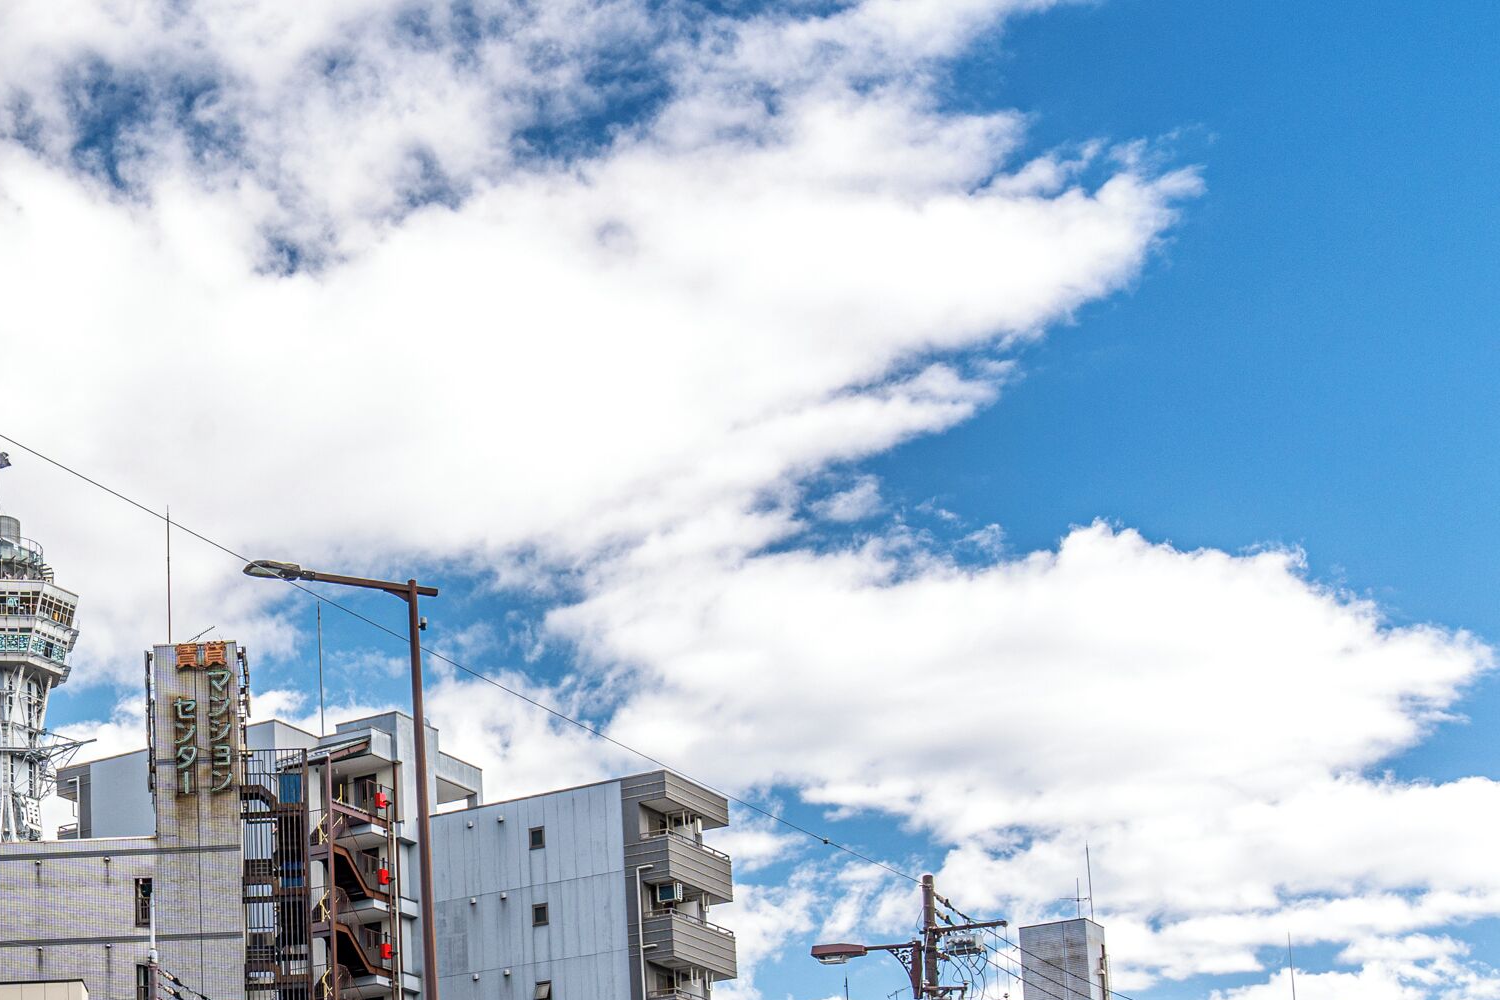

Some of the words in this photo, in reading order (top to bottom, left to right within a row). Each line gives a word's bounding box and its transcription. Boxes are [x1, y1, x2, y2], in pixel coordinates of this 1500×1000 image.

[173, 696, 198, 795] センター
[207, 670, 234, 792] マンション
